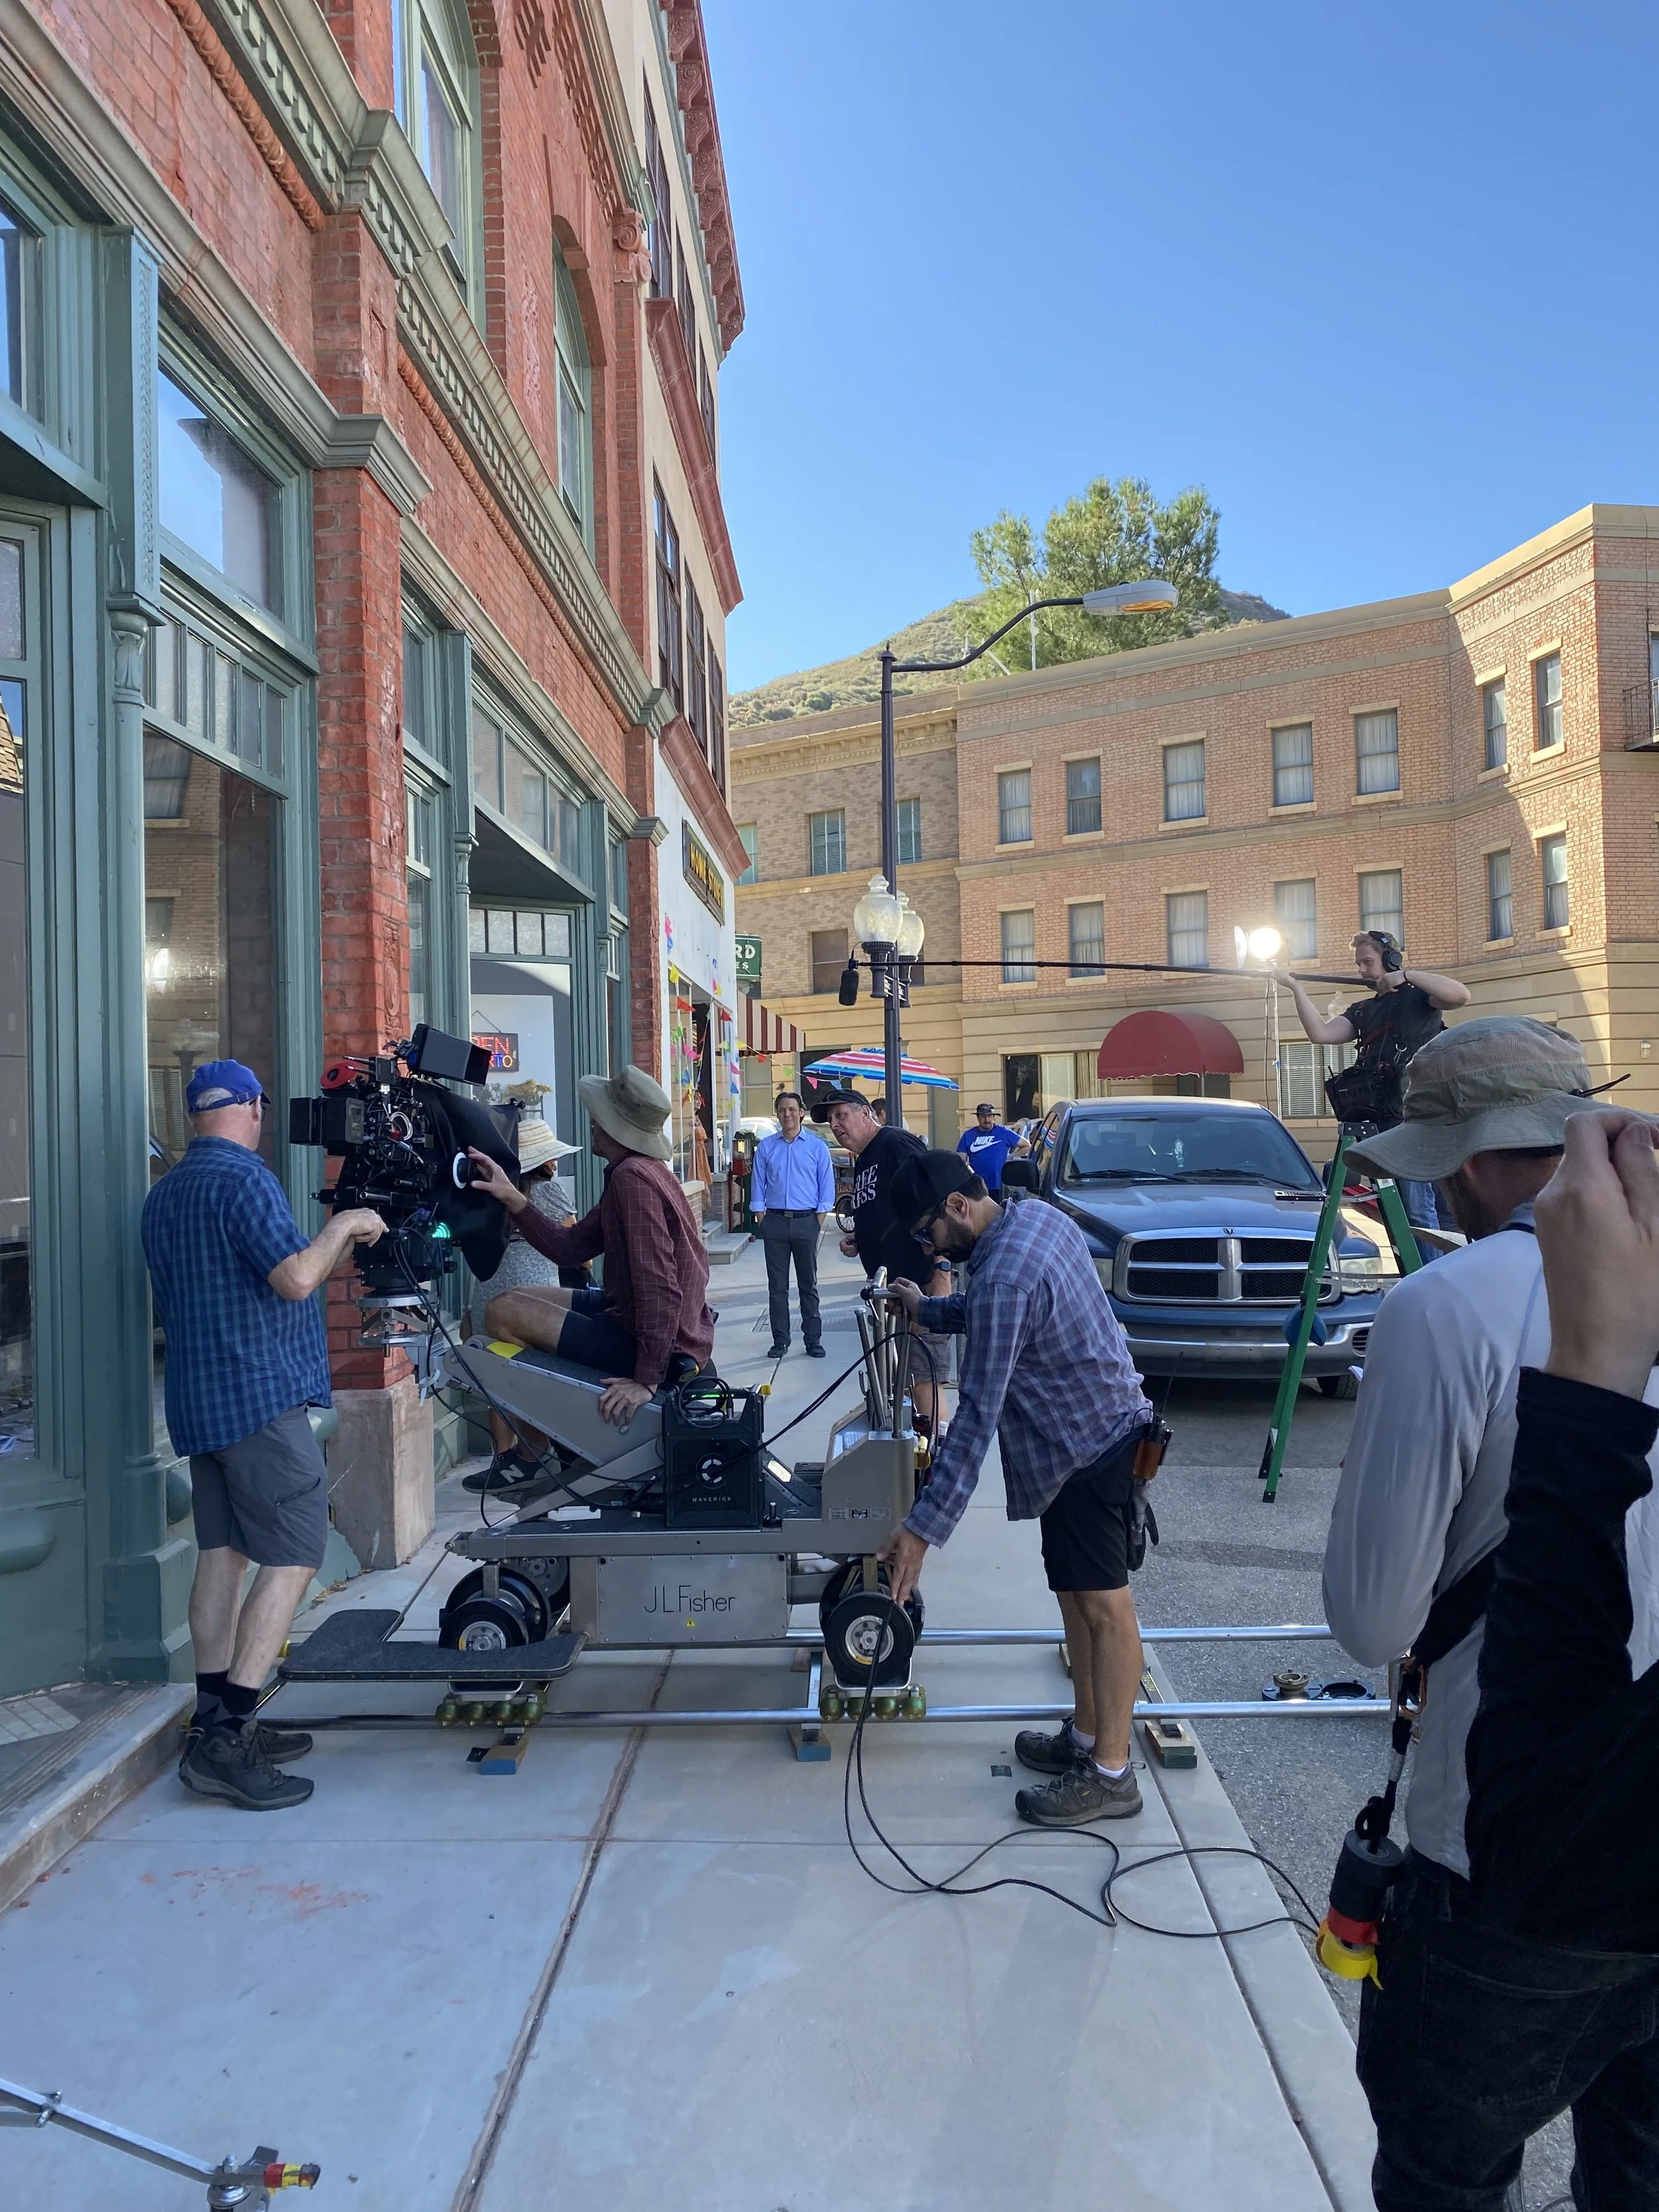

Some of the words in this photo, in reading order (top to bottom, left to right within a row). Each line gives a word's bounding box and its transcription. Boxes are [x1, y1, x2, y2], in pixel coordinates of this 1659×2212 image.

[690, 842, 707, 885] HOME
[974, 1136, 995, 1145] NIKE
[500, 1464, 524, 1483] N
